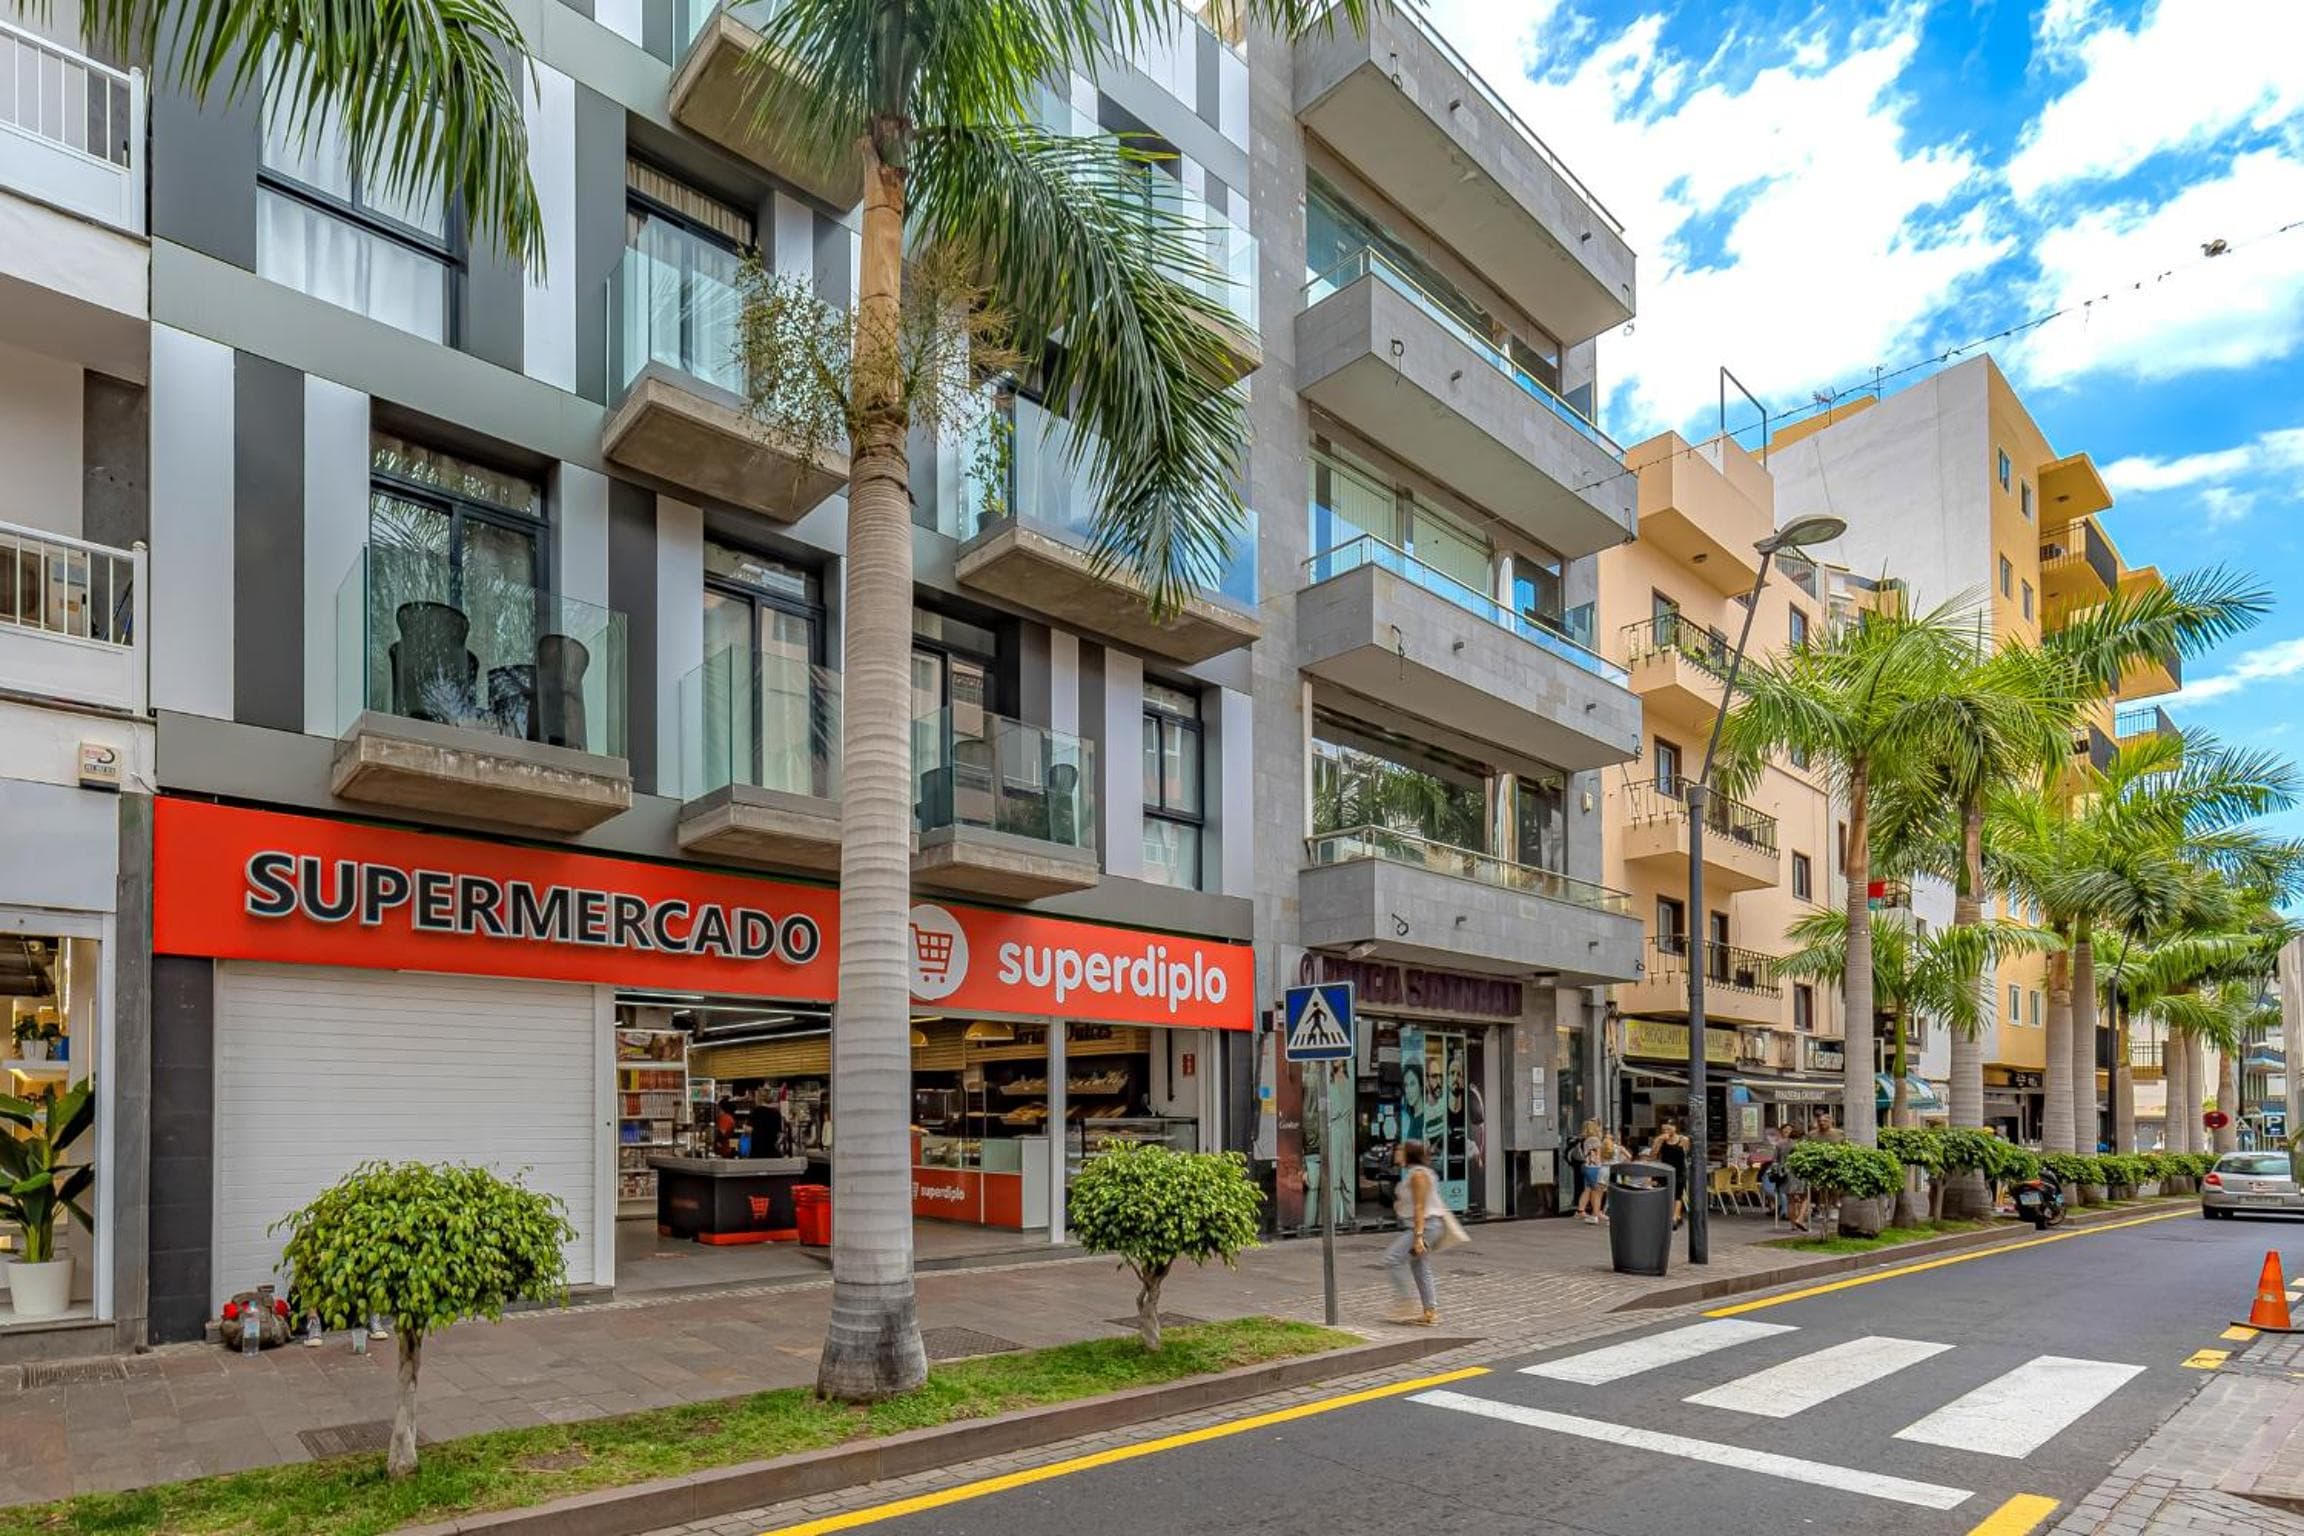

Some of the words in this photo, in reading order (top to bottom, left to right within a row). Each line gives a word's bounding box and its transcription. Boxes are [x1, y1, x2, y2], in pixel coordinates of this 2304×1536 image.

[244, 850, 820, 966] SUPERMERCADO
[998, 941, 1228, 1013] superdiplo
[2266, 1115, 2283, 1128] P
[920, 1184, 966, 1203] superdiplo
